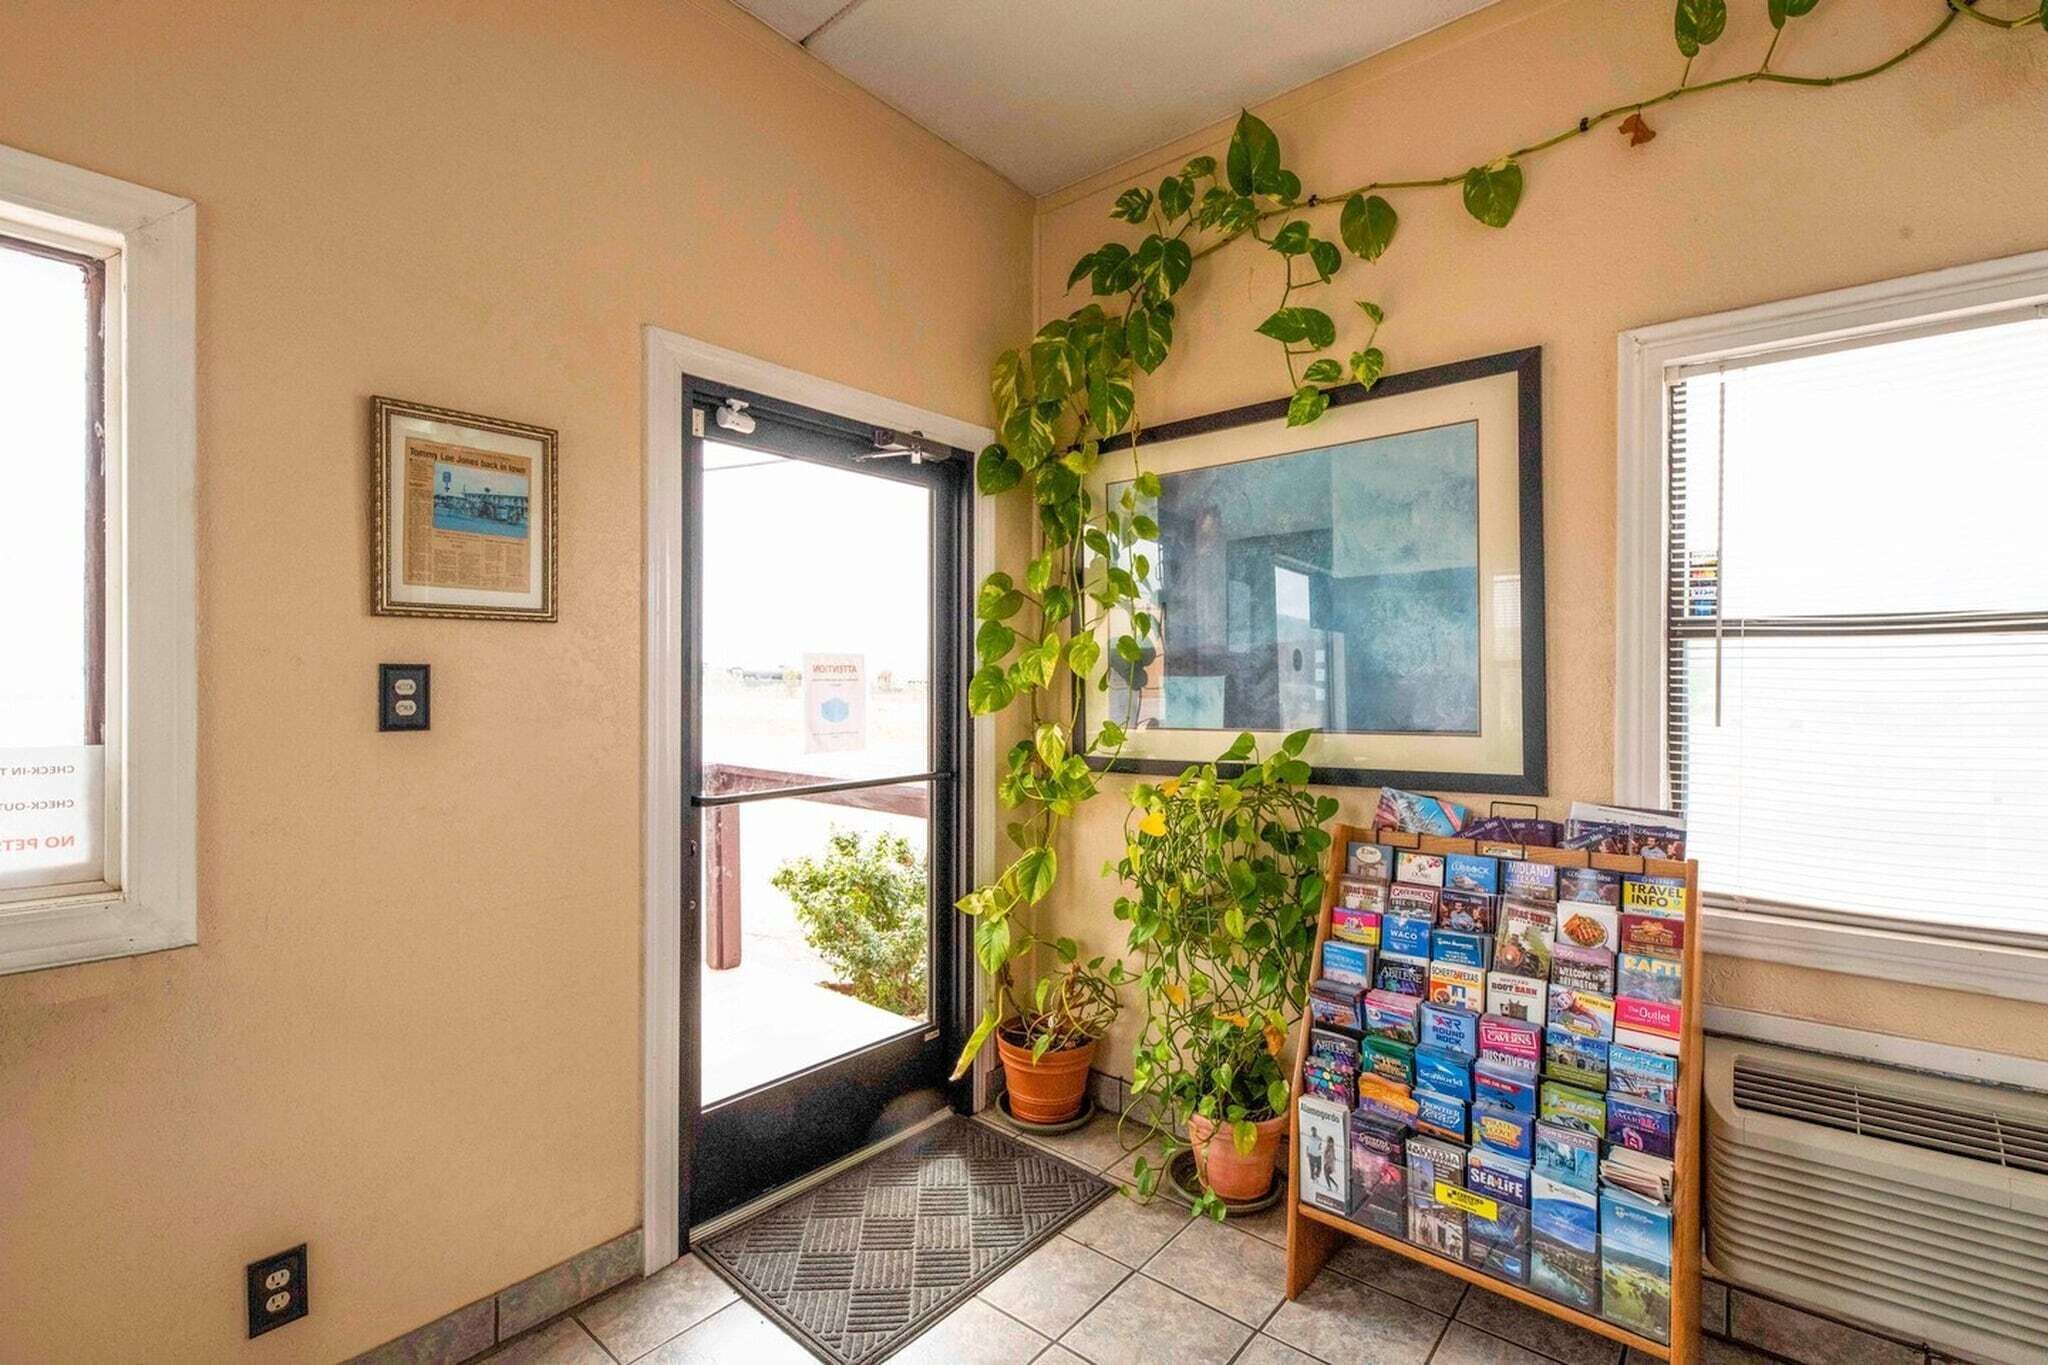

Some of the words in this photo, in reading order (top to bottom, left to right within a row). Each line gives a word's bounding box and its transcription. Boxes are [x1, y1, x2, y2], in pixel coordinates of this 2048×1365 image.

[409, 447, 438, 461] Tommy
[440, 454, 455, 462] Lee
[1508, 861, 1551, 877] MIDLAND
[1630, 883, 1682, 899] TRAVEL
[1632, 895, 1668, 907] INFO
[1390, 929, 1418, 941] WACO
[1491, 982, 1514, 992] BOOT
[1514, 985, 1537, 996] BARN
[1639, 1006, 1671, 1023] Outlet
[1432, 1025, 1465, 1039] ROUND
